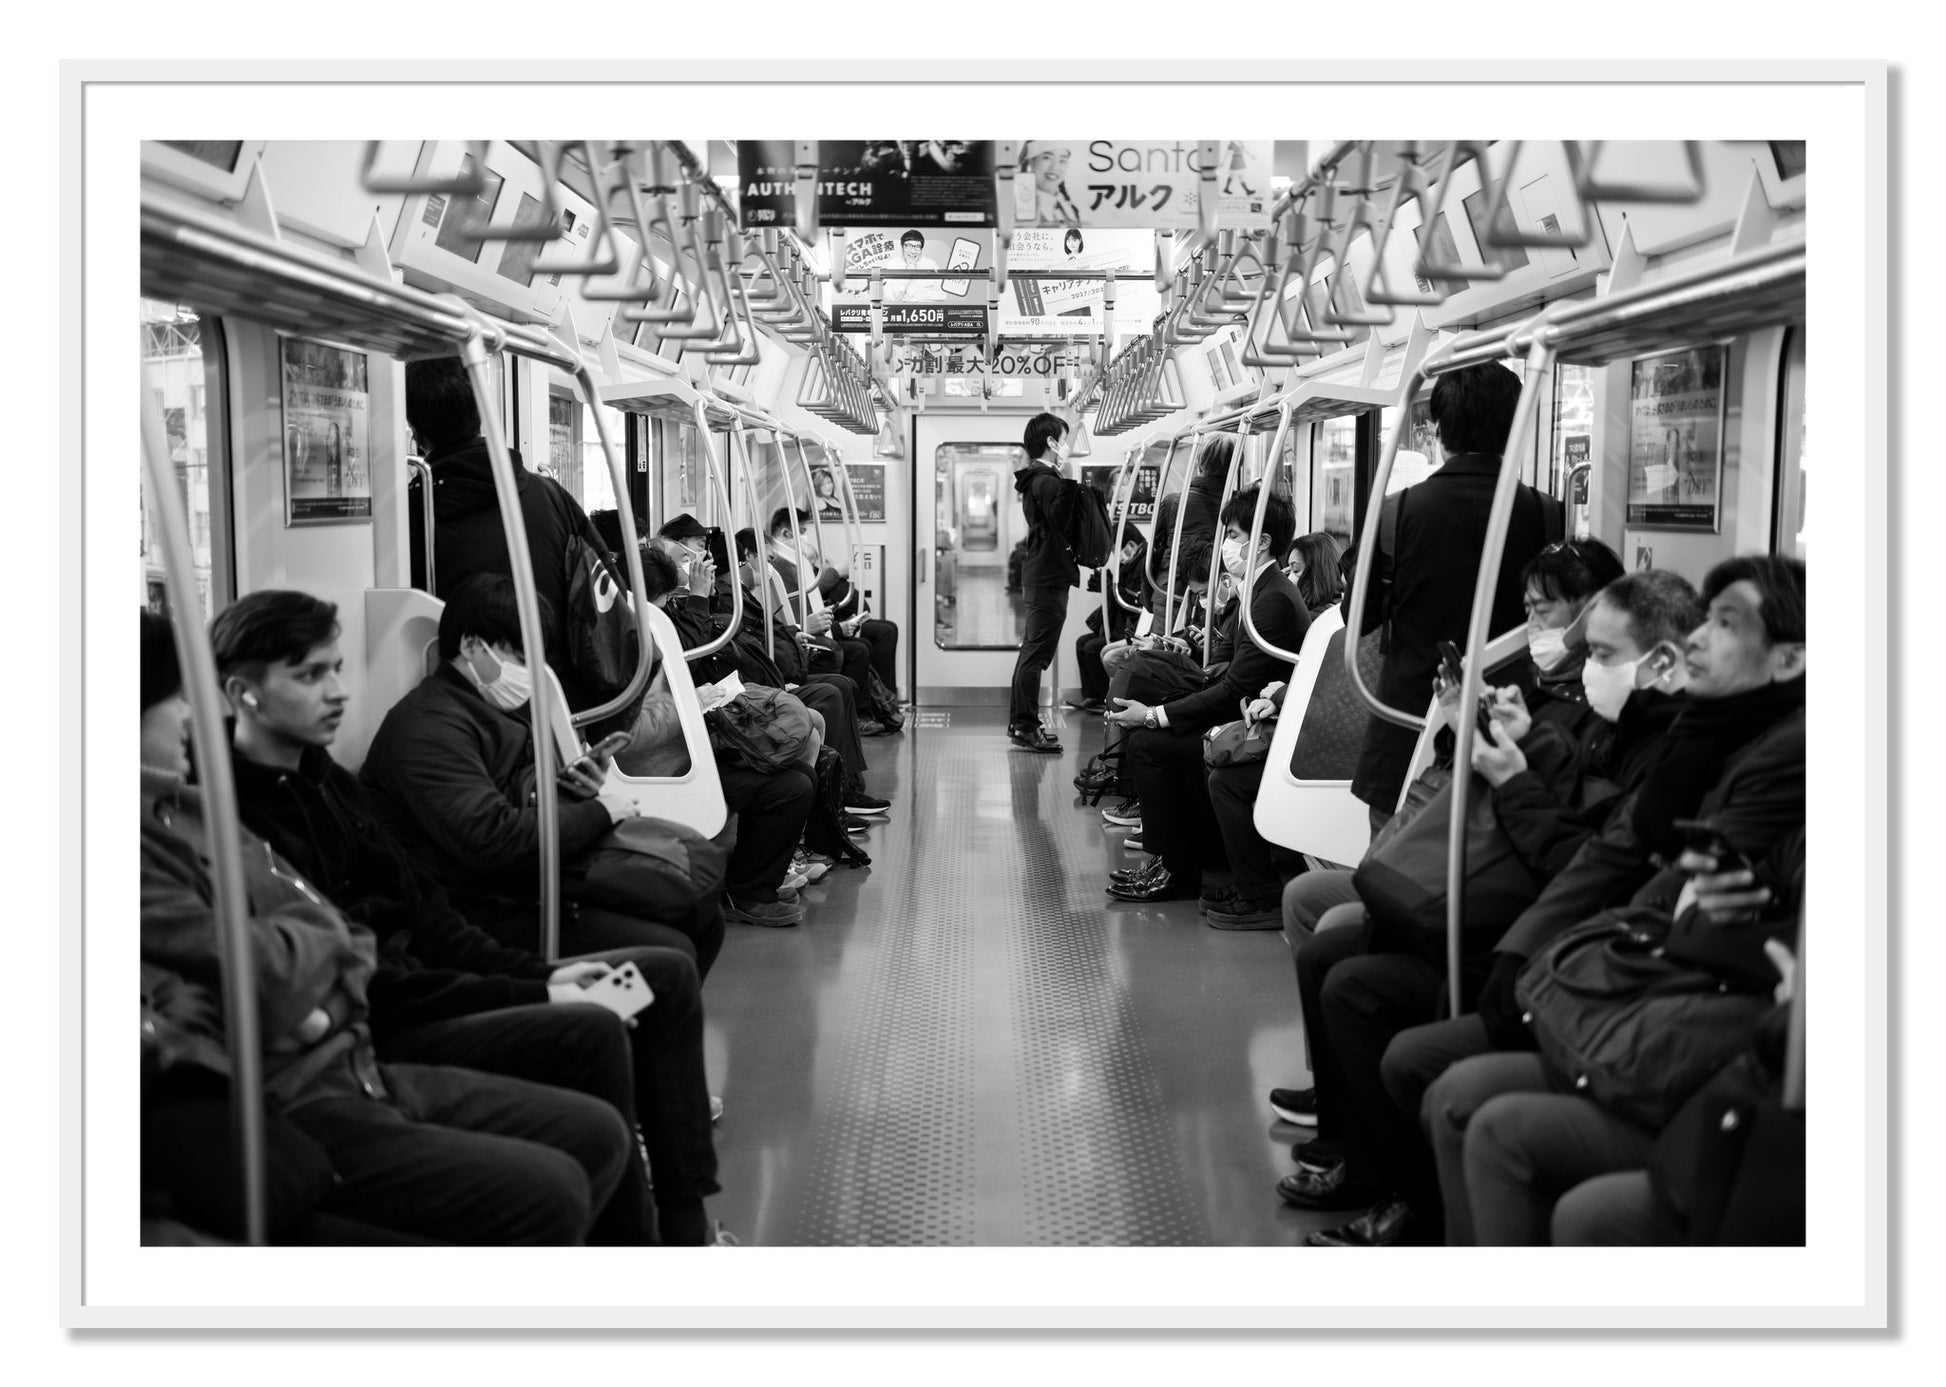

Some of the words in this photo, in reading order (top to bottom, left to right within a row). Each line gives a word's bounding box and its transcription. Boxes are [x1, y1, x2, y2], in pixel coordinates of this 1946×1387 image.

[1087, 184, 1173, 212] アルク
[946, 355, 985, 373] 最大
